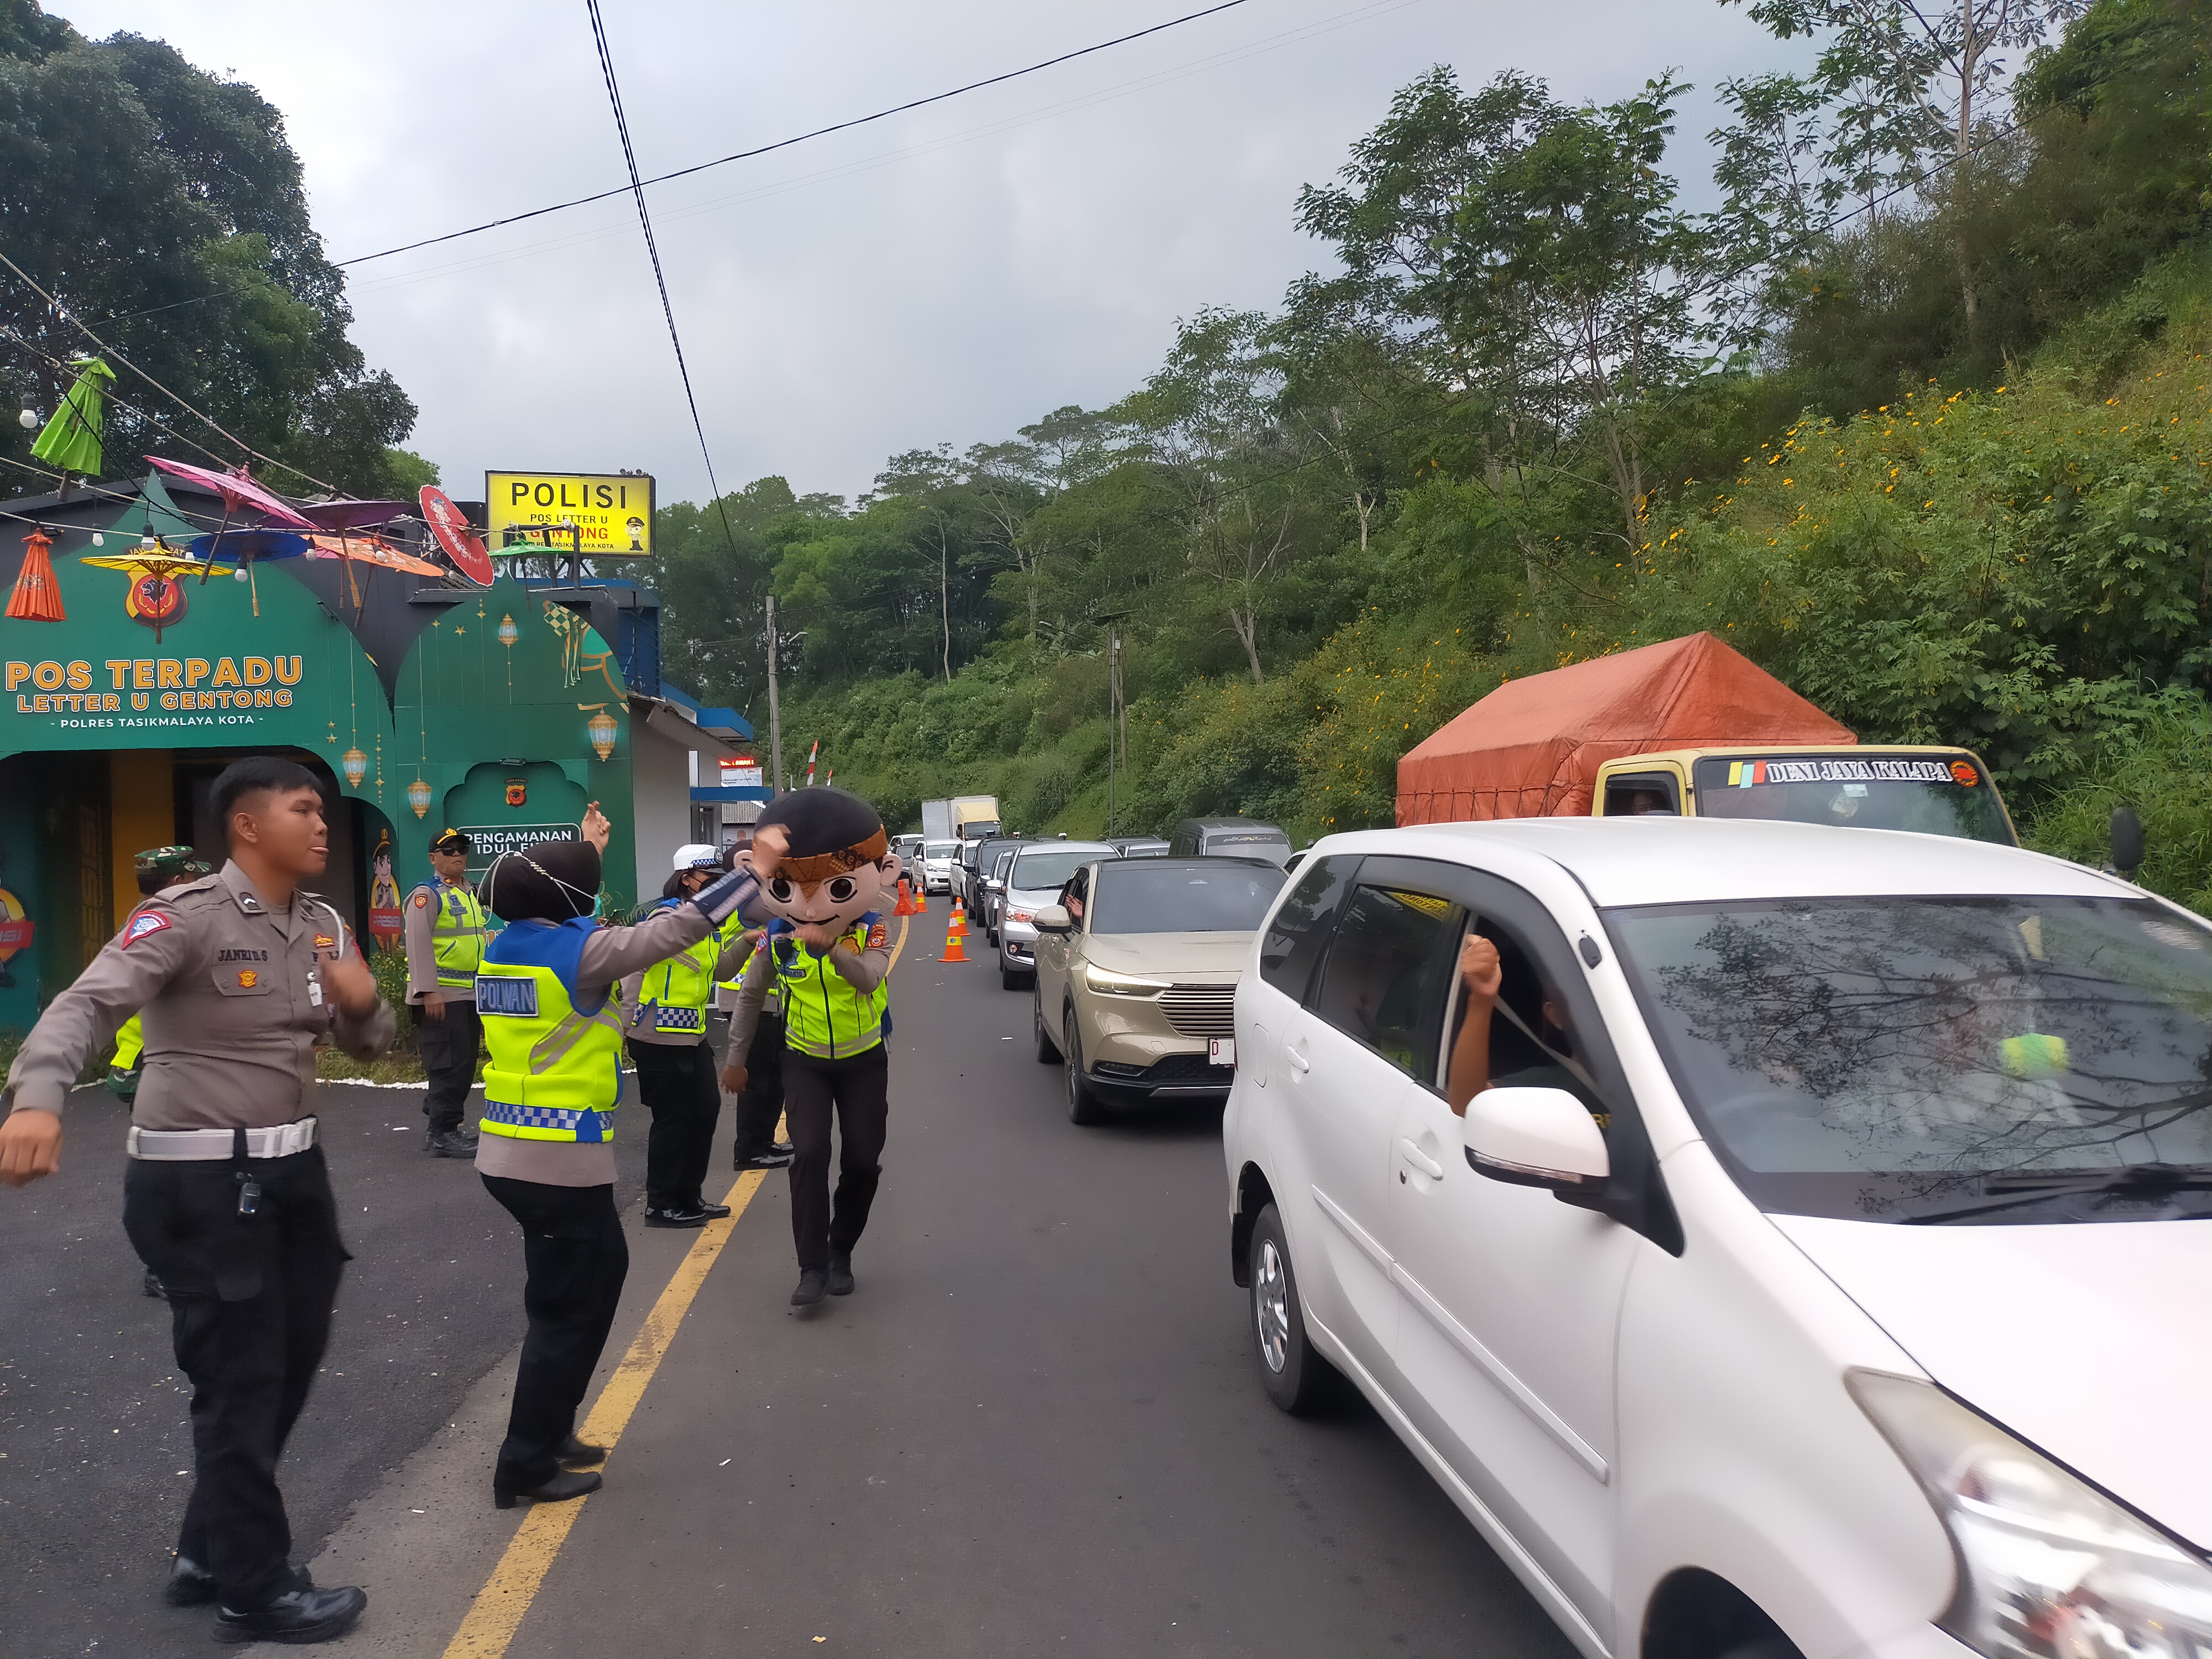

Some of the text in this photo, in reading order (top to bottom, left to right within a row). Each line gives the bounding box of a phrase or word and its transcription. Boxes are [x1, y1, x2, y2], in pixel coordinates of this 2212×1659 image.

[512, 483, 626, 509] POLISI
[530, 514, 551, 522] POS
[6, 655, 303, 691] POS TERPADU
[17, 689, 293, 713] LETTER U GENTONG
[61, 715, 254, 728] POLRES TASIKMALAYA KOTA
[1766, 762, 1821, 782] DENI
[1821, 761, 1875, 781] JAYA
[1872, 761, 1953, 781] KALAPA
[477, 843, 514, 854] IDUL
[478, 982, 535, 1011] POLWAN
[1212, 1041, 1219, 1055] D
